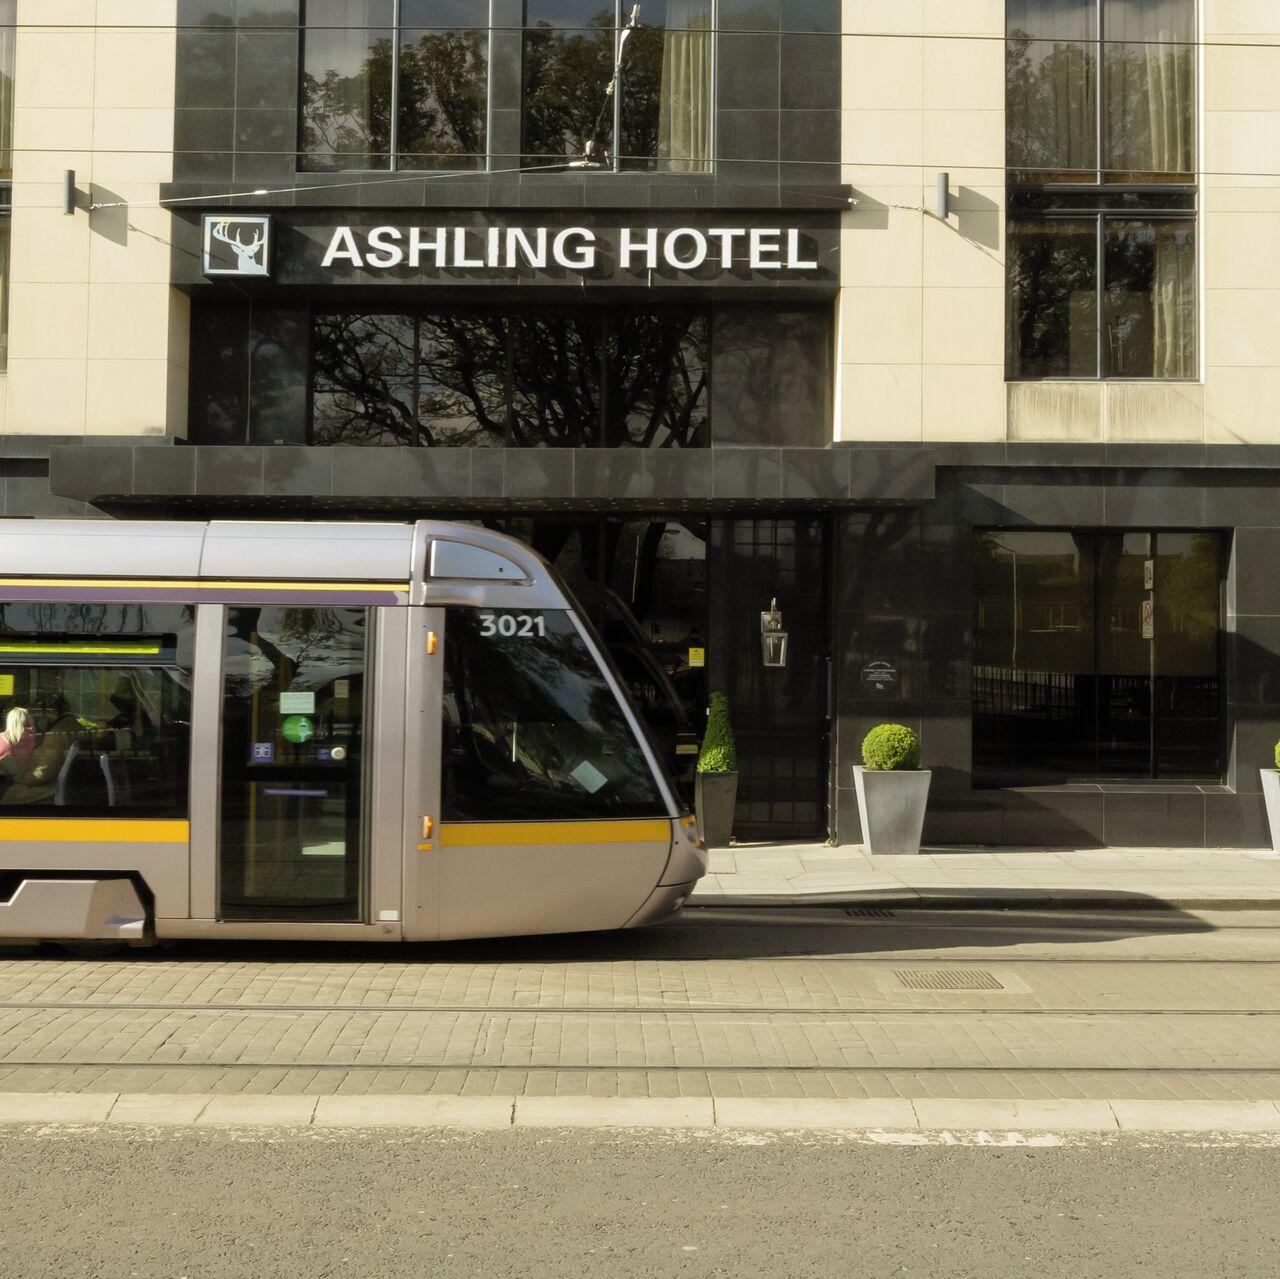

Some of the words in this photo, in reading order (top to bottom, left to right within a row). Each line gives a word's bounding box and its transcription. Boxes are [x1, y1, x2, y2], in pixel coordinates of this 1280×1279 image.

[321, 225, 596, 269] ASHLING
[620, 227, 818, 269] HOTEL
[479, 614, 546, 637] 3021
